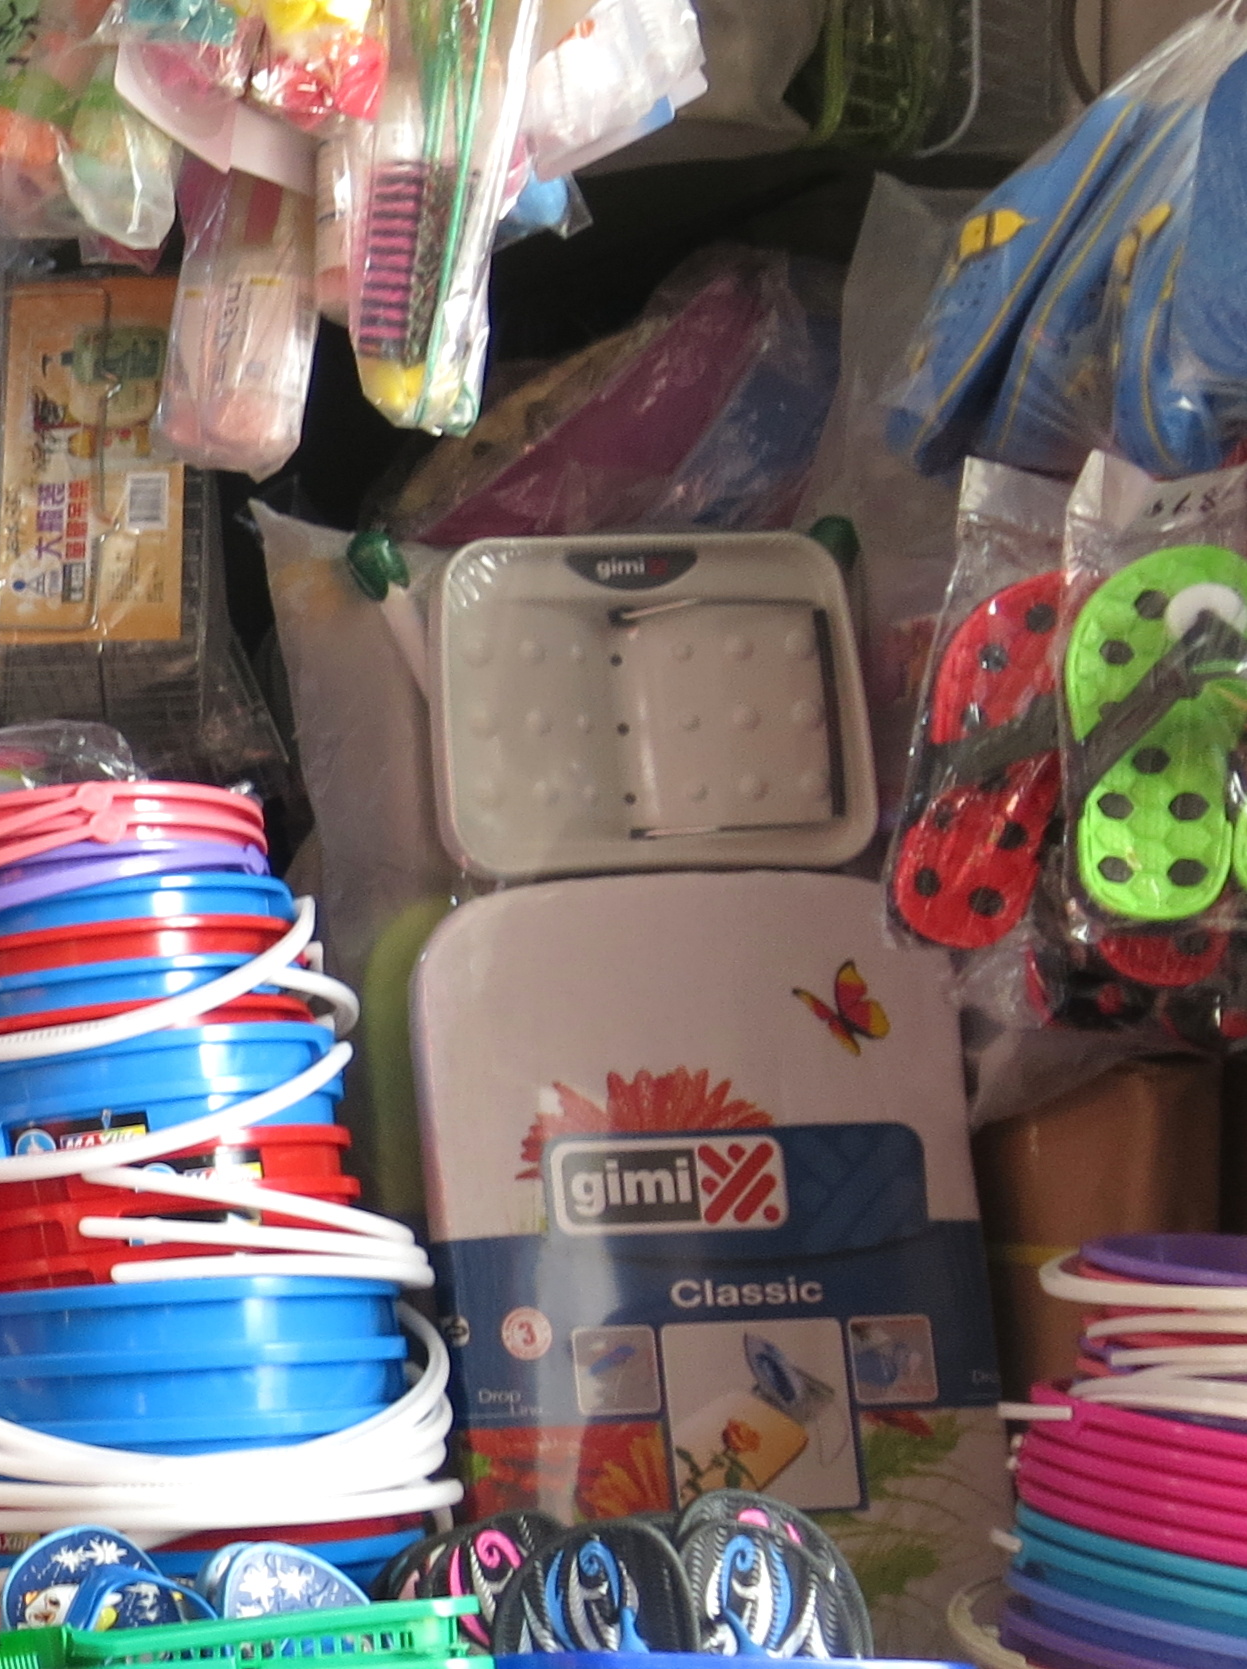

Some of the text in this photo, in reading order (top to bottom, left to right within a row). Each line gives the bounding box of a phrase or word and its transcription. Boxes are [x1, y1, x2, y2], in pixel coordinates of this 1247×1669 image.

[597, 556, 645, 580] gimi
[571, 1158, 694, 1218] gimi
[670, 1275, 824, 1308] Classic
[479, 1389, 522, 1408] Drop
